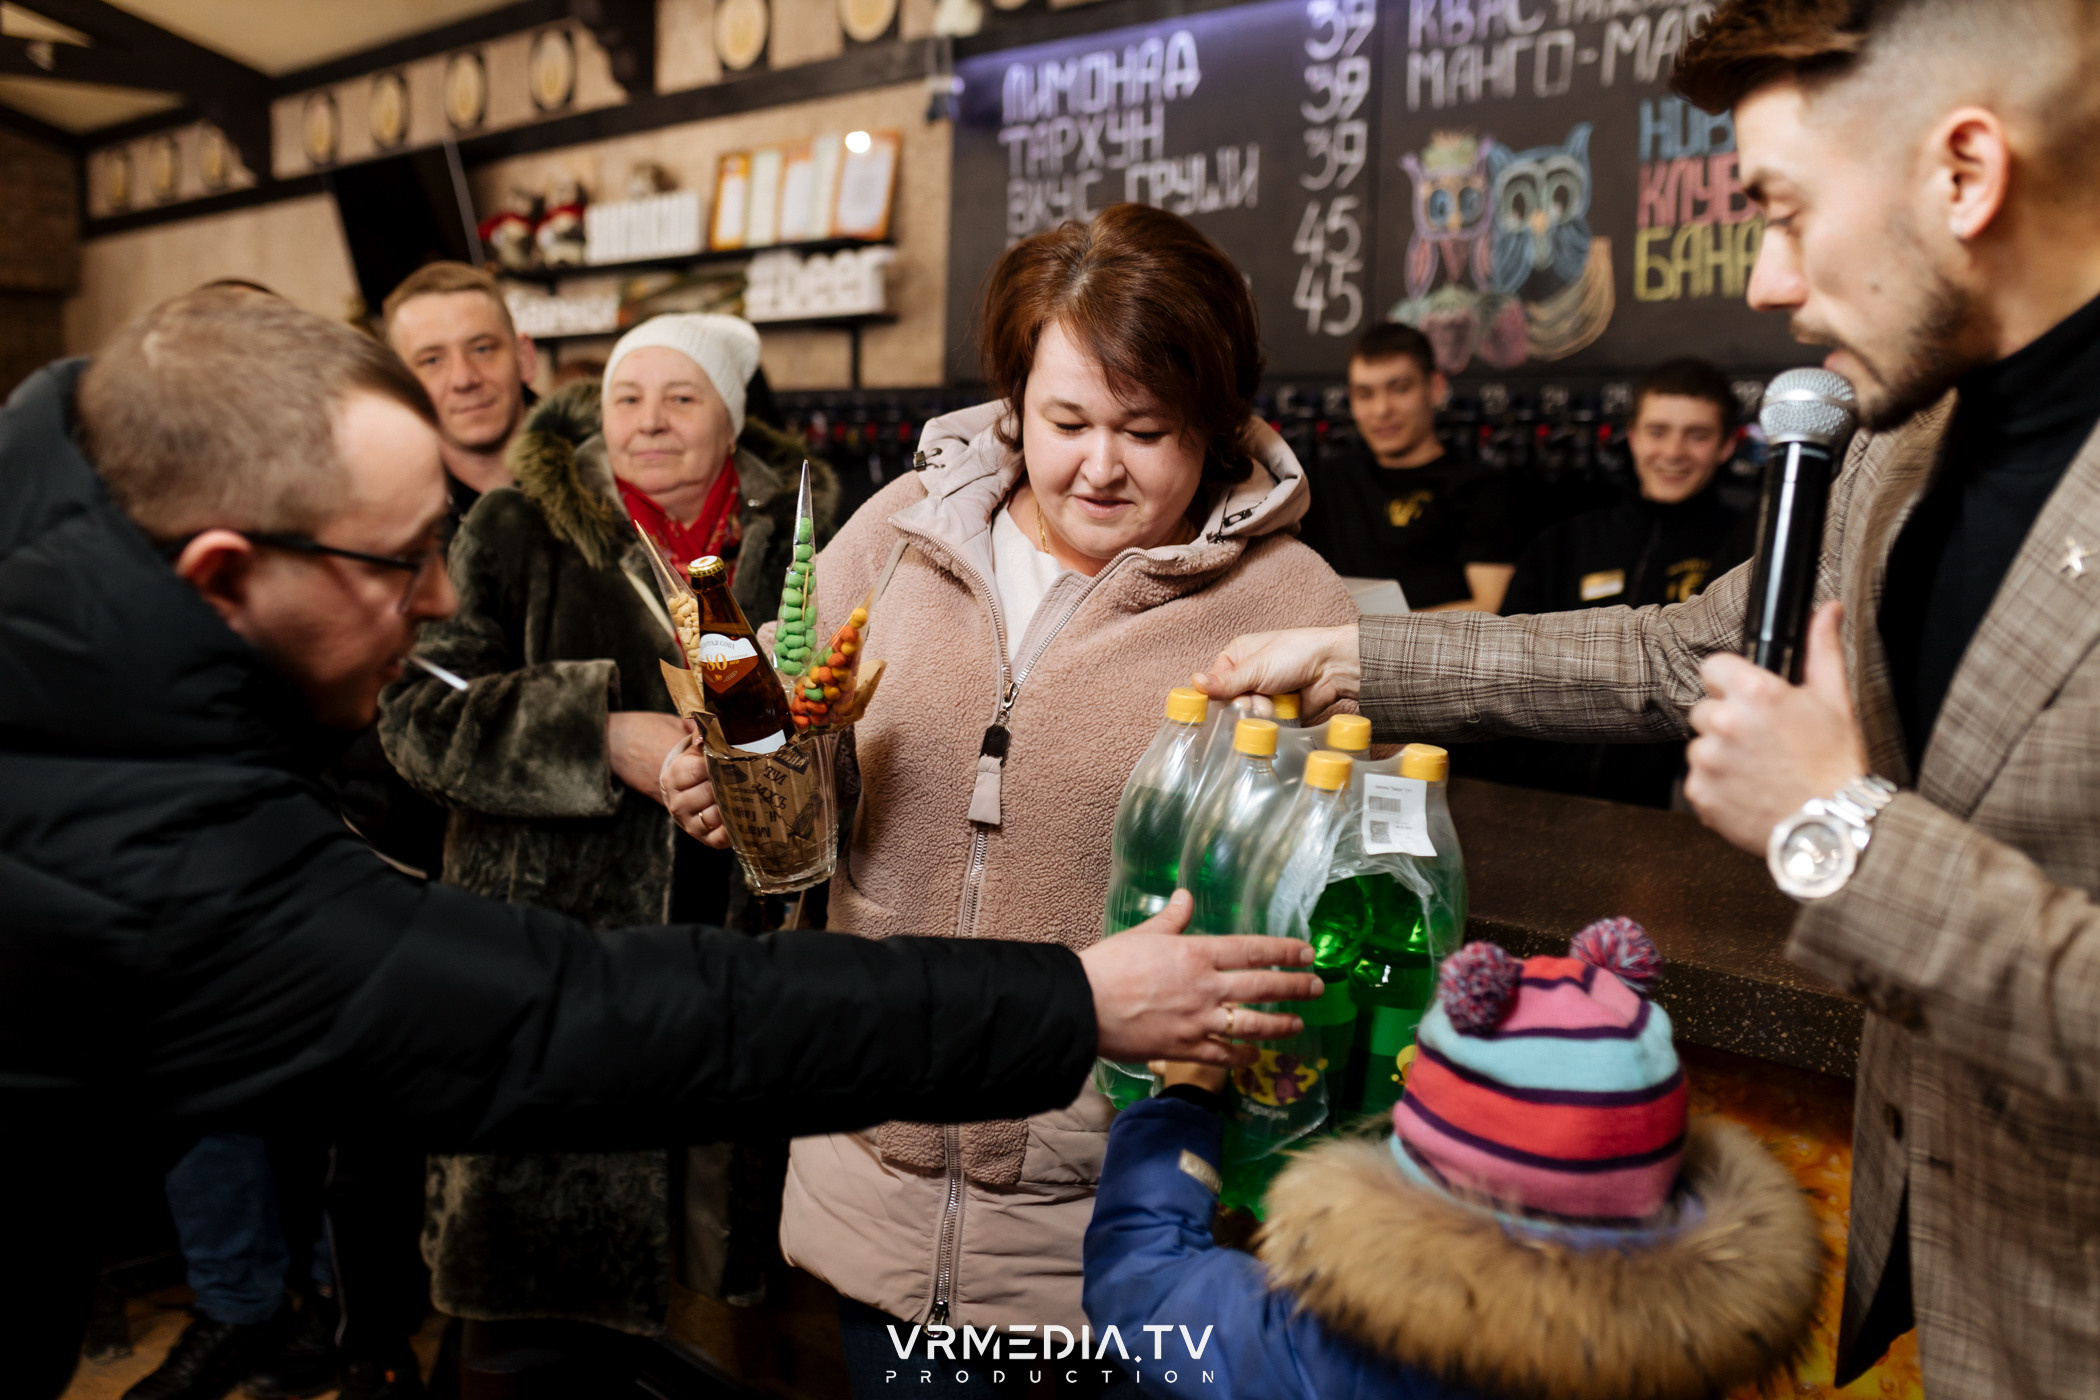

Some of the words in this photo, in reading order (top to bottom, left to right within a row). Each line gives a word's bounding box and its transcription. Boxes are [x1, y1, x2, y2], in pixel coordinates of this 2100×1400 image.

[1299, 55, 1370, 122] 39
[997, 101, 1165, 180] ТАРХУН
[1299, 118, 1368, 191] 39
[1007, 167, 1103, 235] ВКУС
[1125, 144, 1258, 216] ГРУШИ
[1293, 195, 1361, 266] 45
[1293, 258, 1363, 337] 45
